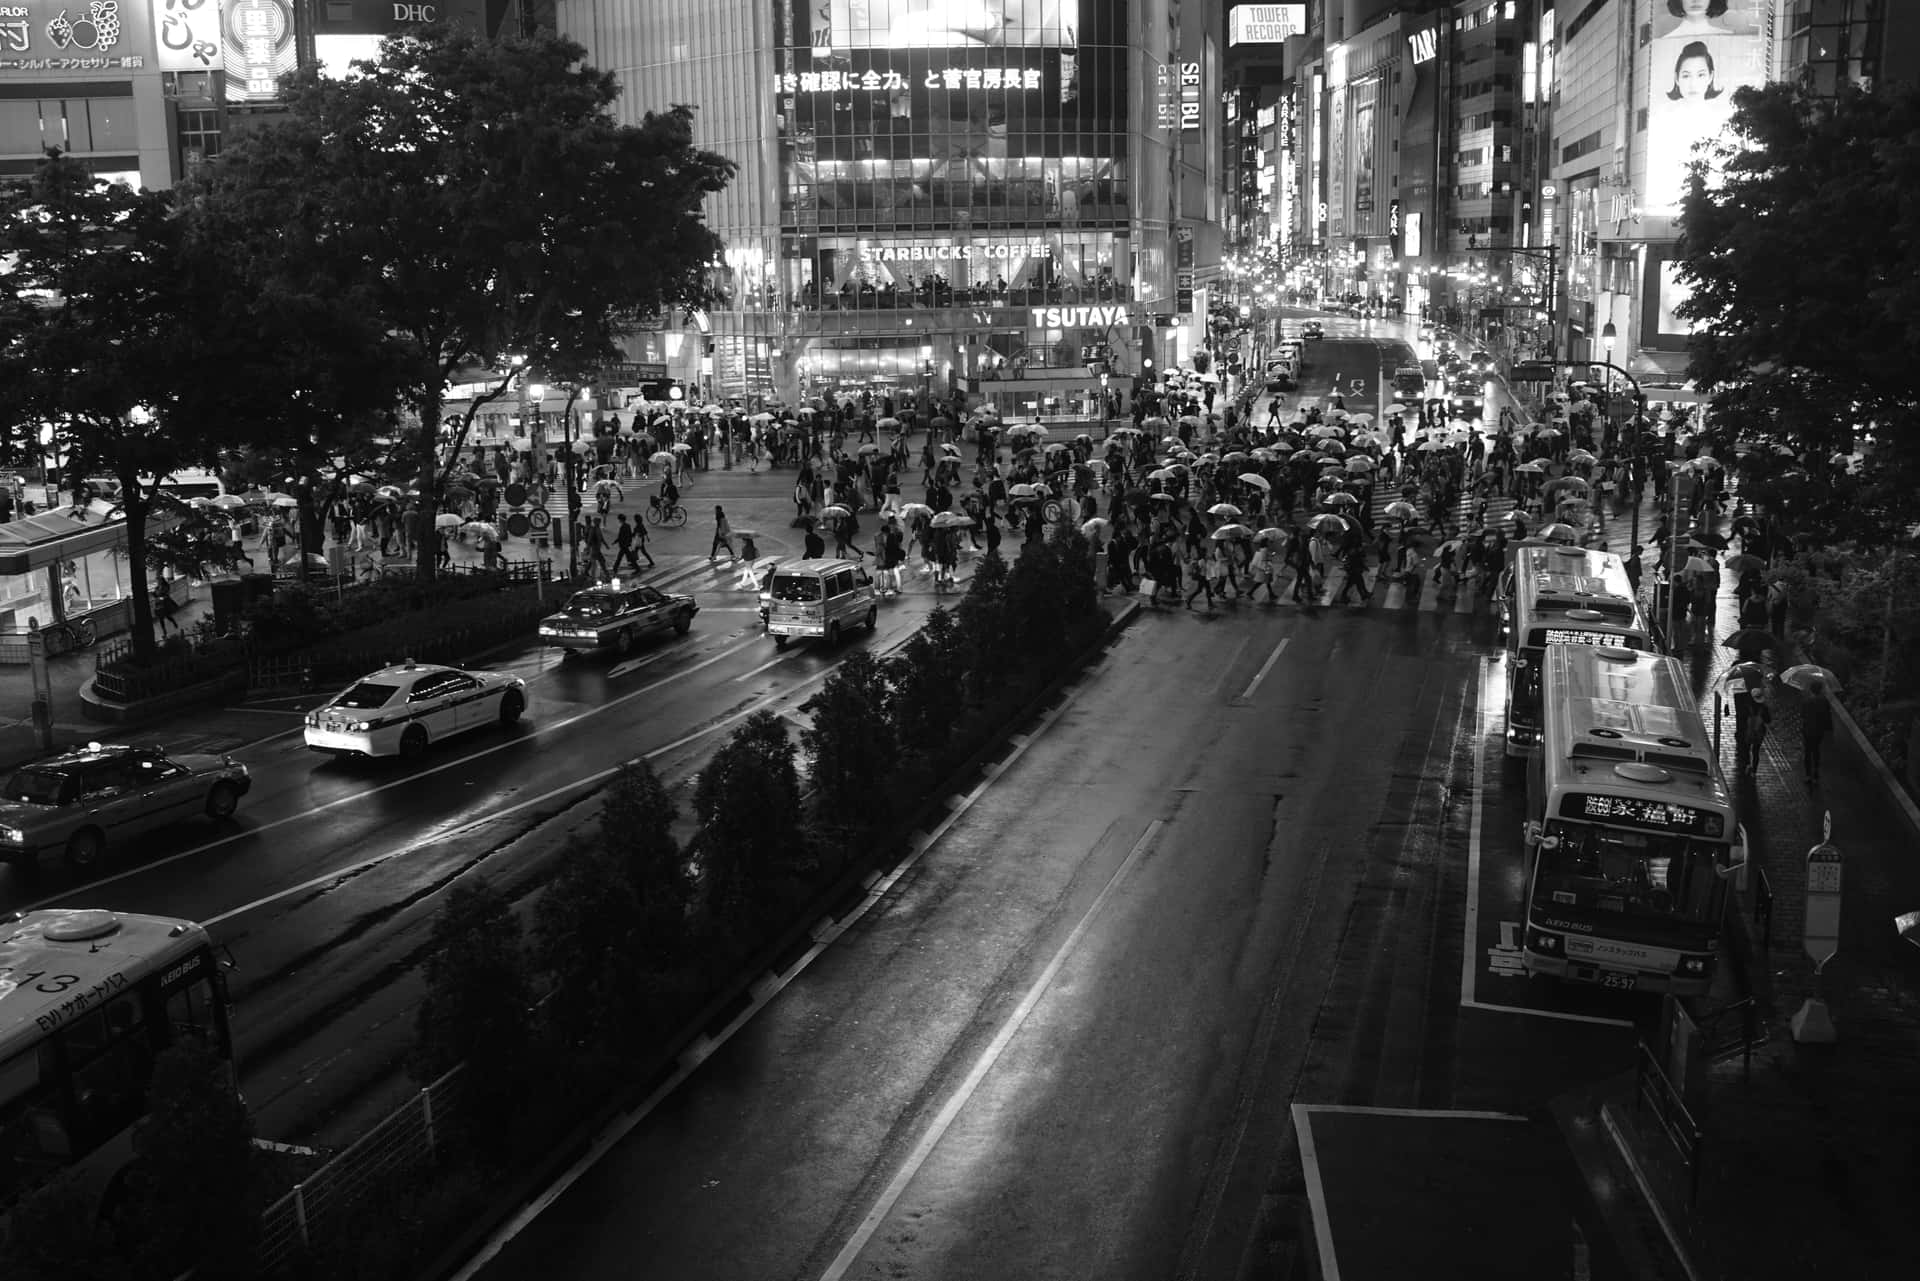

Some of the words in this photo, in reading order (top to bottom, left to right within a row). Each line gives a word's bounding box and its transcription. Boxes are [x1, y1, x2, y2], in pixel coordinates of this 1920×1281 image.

[0, 7, 29, 17] RLOR
[393, 3, 436, 22] DHC
[1250, 7, 1289, 23] TOWER
[774, 68, 1041, 93] き確認に全力、と菅官房長官
[1181, 62, 1200, 130] SEIBU
[1280, 95, 1289, 147] KARAOKE
[1390, 204, 1399, 236] ZARA
[860, 246, 972, 262] STARBUCKS
[984, 244, 1051, 259] COFFEE
[1031, 306, 1129, 328] TSUTAYA
[160, 966, 182, 988] KEIO
[182, 954, 201, 975] BUS
